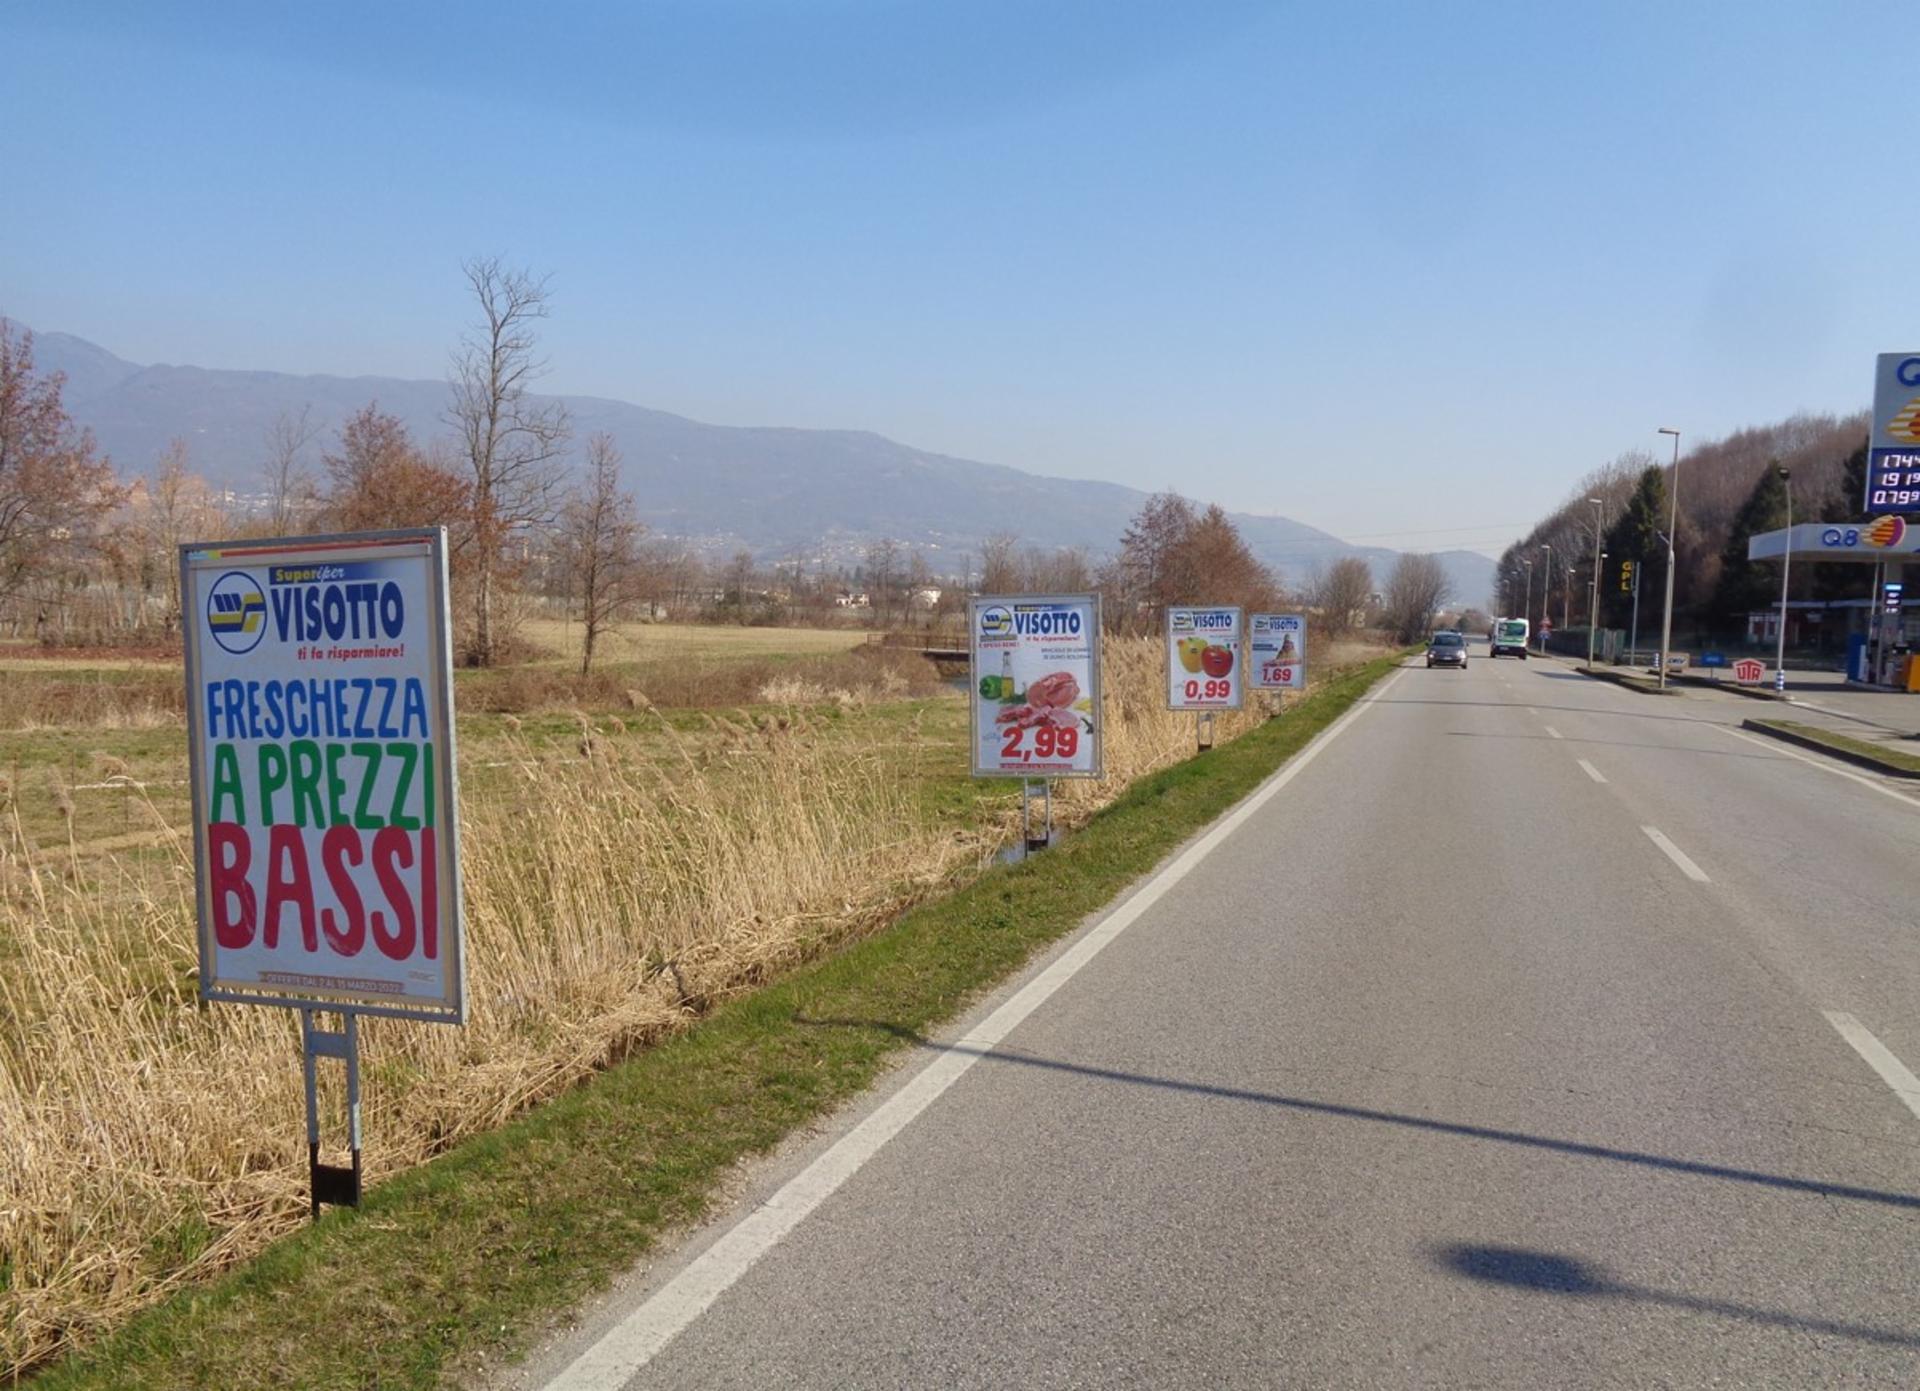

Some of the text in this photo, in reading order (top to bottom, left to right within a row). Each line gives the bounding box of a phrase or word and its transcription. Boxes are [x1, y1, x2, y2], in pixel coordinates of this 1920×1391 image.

[1822, 528, 1858, 547] Q8
[1622, 561, 1632, 590] GPL
[270, 581, 404, 642] VISOTTO
[1193, 615, 1232, 627] VISOTTO
[1015, 612, 1081, 634] VISOTTO
[1269, 620, 1298, 630] VISOTTO
[298, 643, 404, 661] ti fa risparmiare!
[1262, 668, 1292, 683] 1,69
[1184, 680, 1231, 700] 0,99
[207, 677, 428, 739] FRESCHEZZA
[1001, 726, 1078, 762] 2,99
[211, 739, 435, 831] A PREZZI
[208, 821, 438, 961] BASSI
